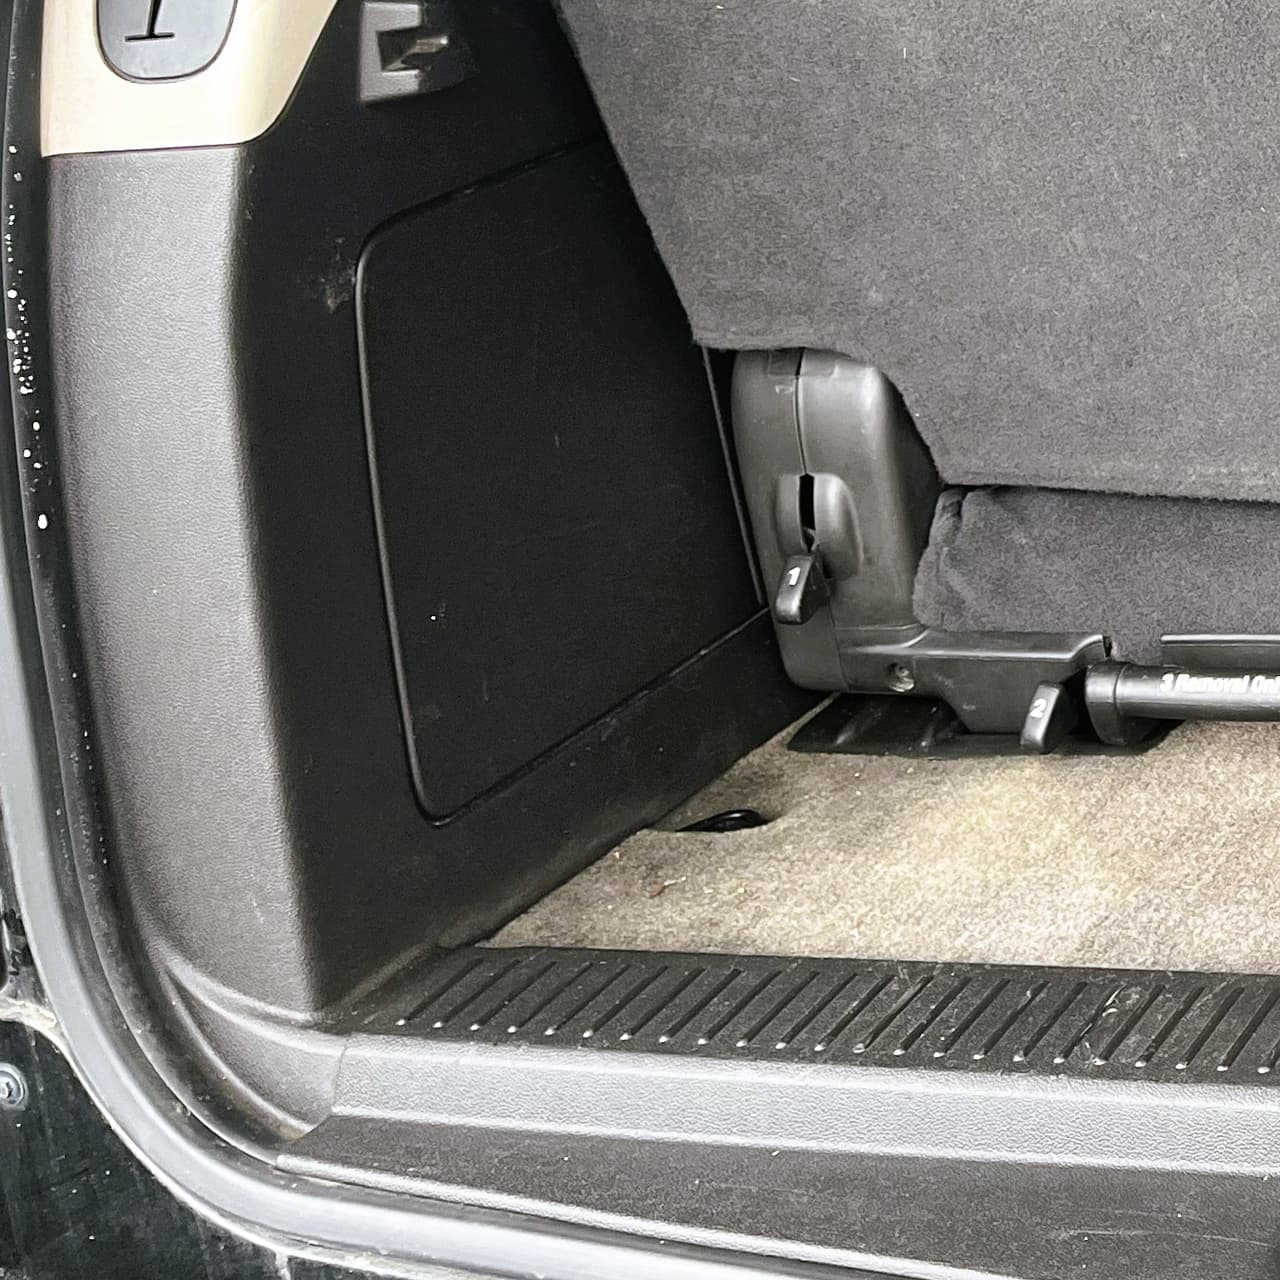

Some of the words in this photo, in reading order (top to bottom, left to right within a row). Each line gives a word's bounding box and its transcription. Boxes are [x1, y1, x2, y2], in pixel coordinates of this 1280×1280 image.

[787, 566, 801, 587] 1
[1160, 673, 1174, 692] 3
[1175, 673, 1250, 693] Removal
[1030, 698, 1047, 718] 2
